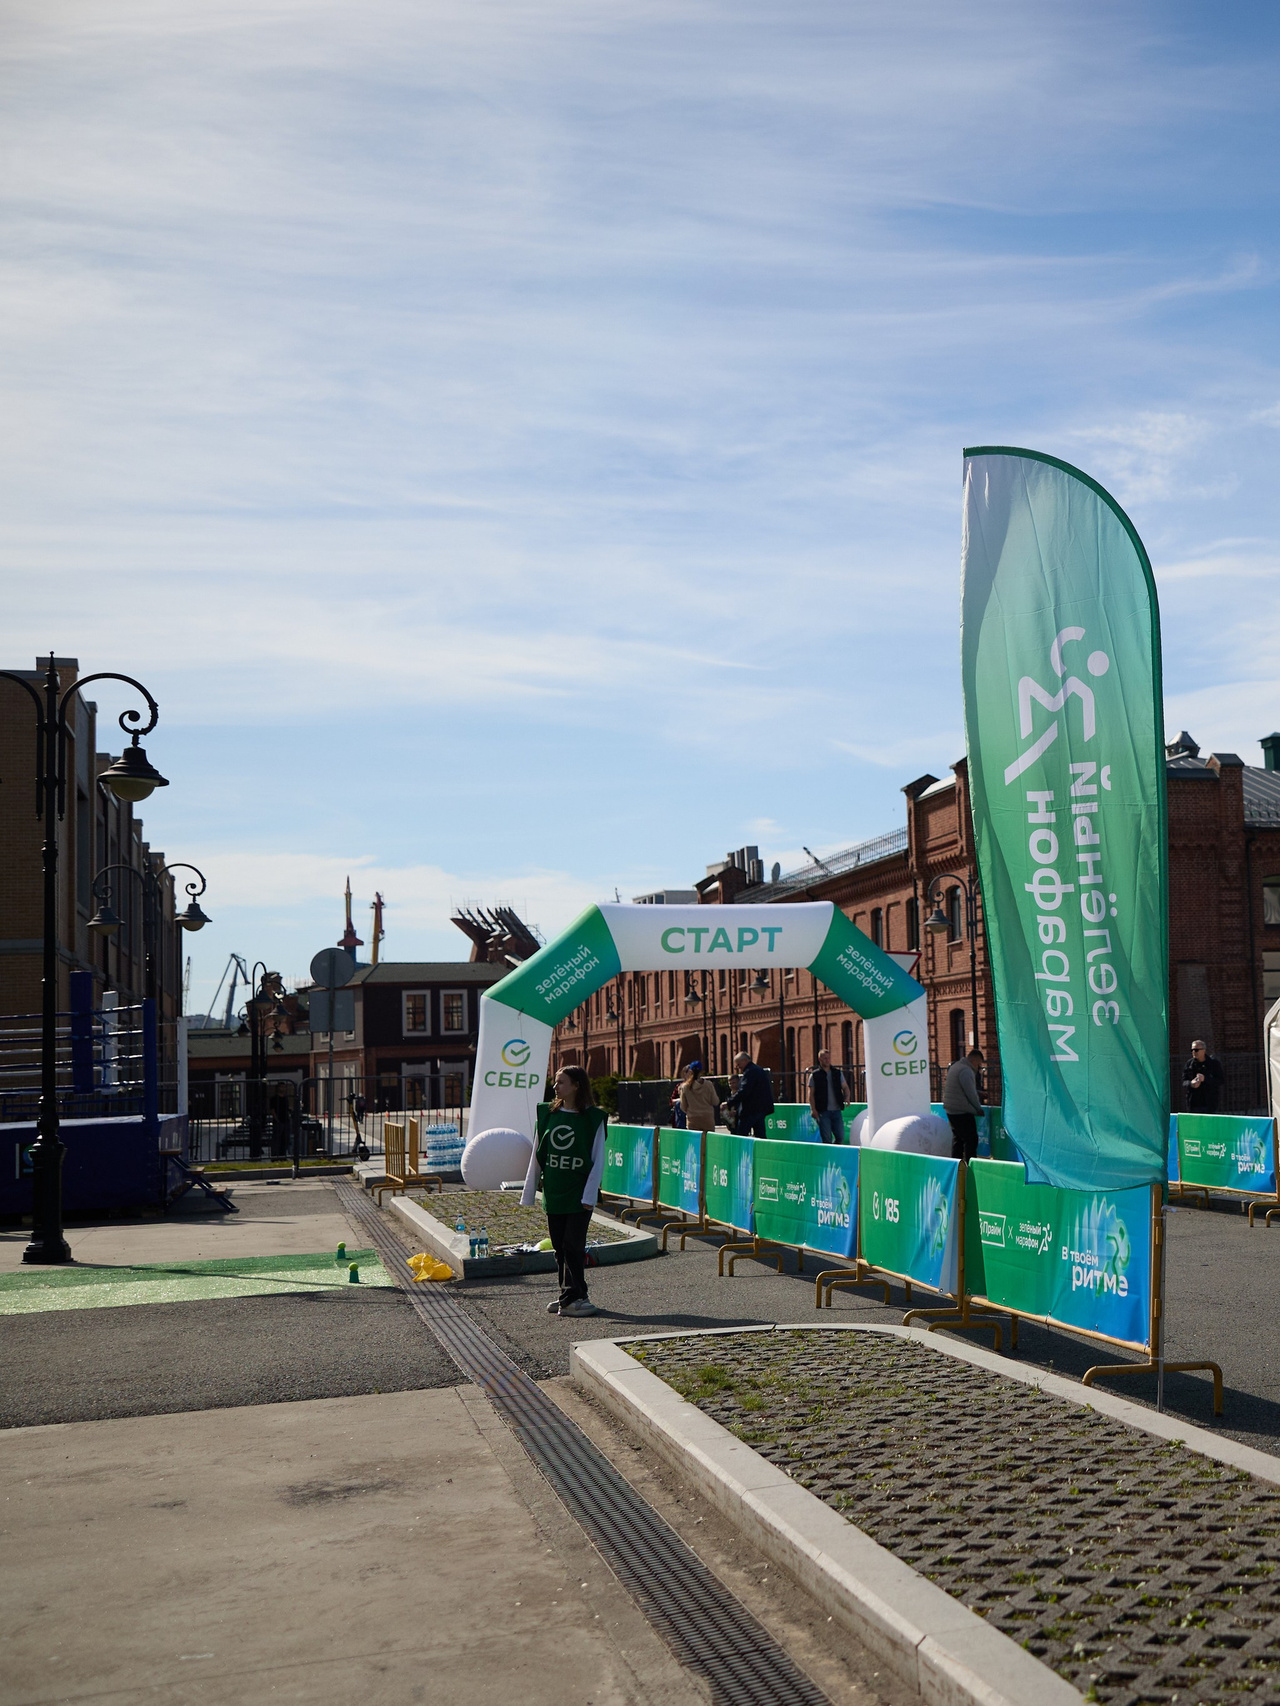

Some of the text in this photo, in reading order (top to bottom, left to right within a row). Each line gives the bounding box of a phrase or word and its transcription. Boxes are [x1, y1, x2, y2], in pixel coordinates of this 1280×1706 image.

[660, 927, 783, 954] СТАРТ
[535, 944, 592, 995] зелёный
[836, 953, 886, 998] марафон
[844, 944, 895, 989] зелёный
[544, 956, 600, 1004] марафон
[881, 1059, 927, 1077] СБЕР
[484, 1070, 540, 1090] СБЕР
[776, 1119, 787, 1129] 185
[614, 1152, 624, 1167] 185
[1237, 1161, 1265, 1175] ритме
[719, 1169, 728, 1187] 185
[817, 1209, 850, 1228] ритме
[884, 1198, 900, 1223] 185
[983, 1219, 1002, 1238] Прайм
[1018, 1220, 1042, 1236] зелёный
[1015, 1233, 1039, 1249] марафон
[1070, 1249, 1099, 1267] твоём
[1072, 1265, 1129, 1297] ритме
